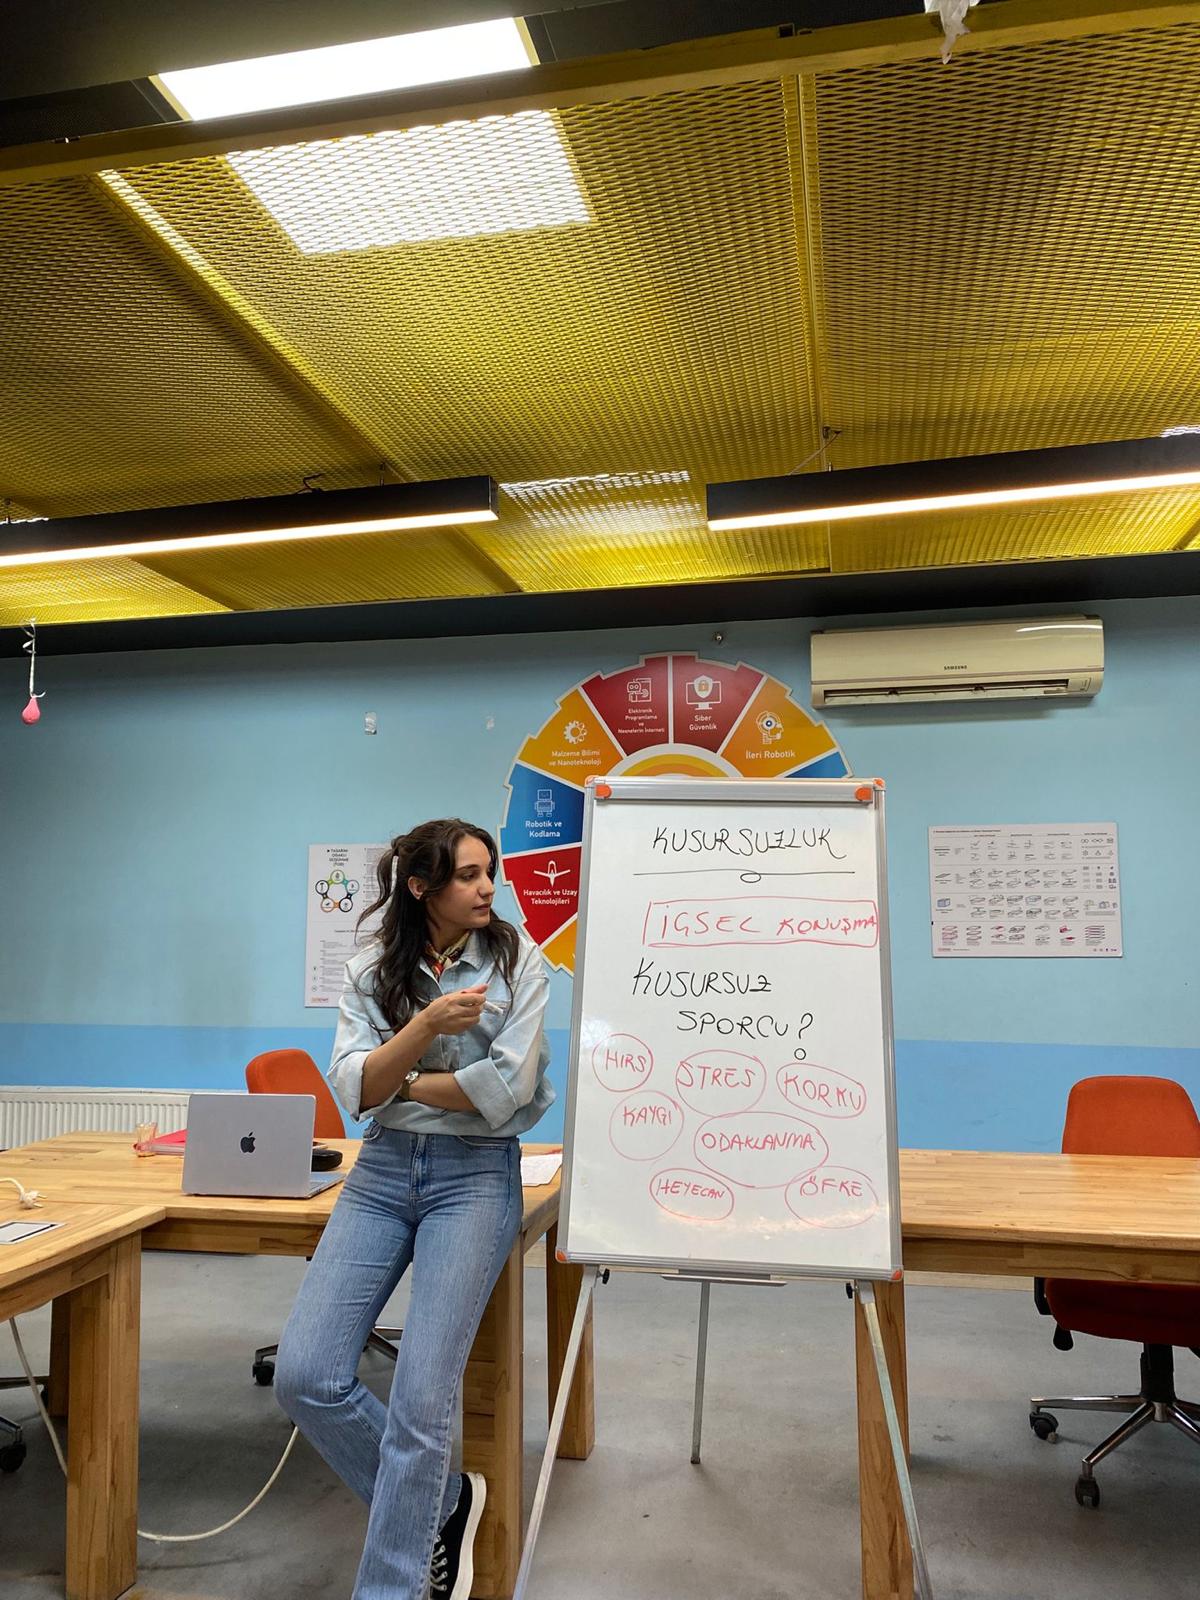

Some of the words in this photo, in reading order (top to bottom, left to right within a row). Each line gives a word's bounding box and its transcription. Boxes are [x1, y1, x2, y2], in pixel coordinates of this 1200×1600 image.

[694, 714, 713, 722] Siber
[557, 759, 602, 767] Nanoteknoloji
[745, 749, 762, 759] İleri
[764, 749, 796, 759] Robotik
[525, 820, 553, 828] Robotik
[652, 826, 847, 860] KUSURSUZLUK
[523, 889, 552, 897] Havacılık
[562, 889, 578, 897] Uzay
[531, 898, 571, 906] Teknolojileri
[632, 956, 772, 998] KUSURSUZ
[604, 1048, 647, 1073] HIRS
[677, 1060, 756, 1090] STRES
[783, 1071, 862, 1111] KORKU
[700, 1132, 816, 1153] ODAKLANMA
[655, 1178, 726, 1200] HEYECAN
[799, 1175, 863, 1198] ÖFKE
